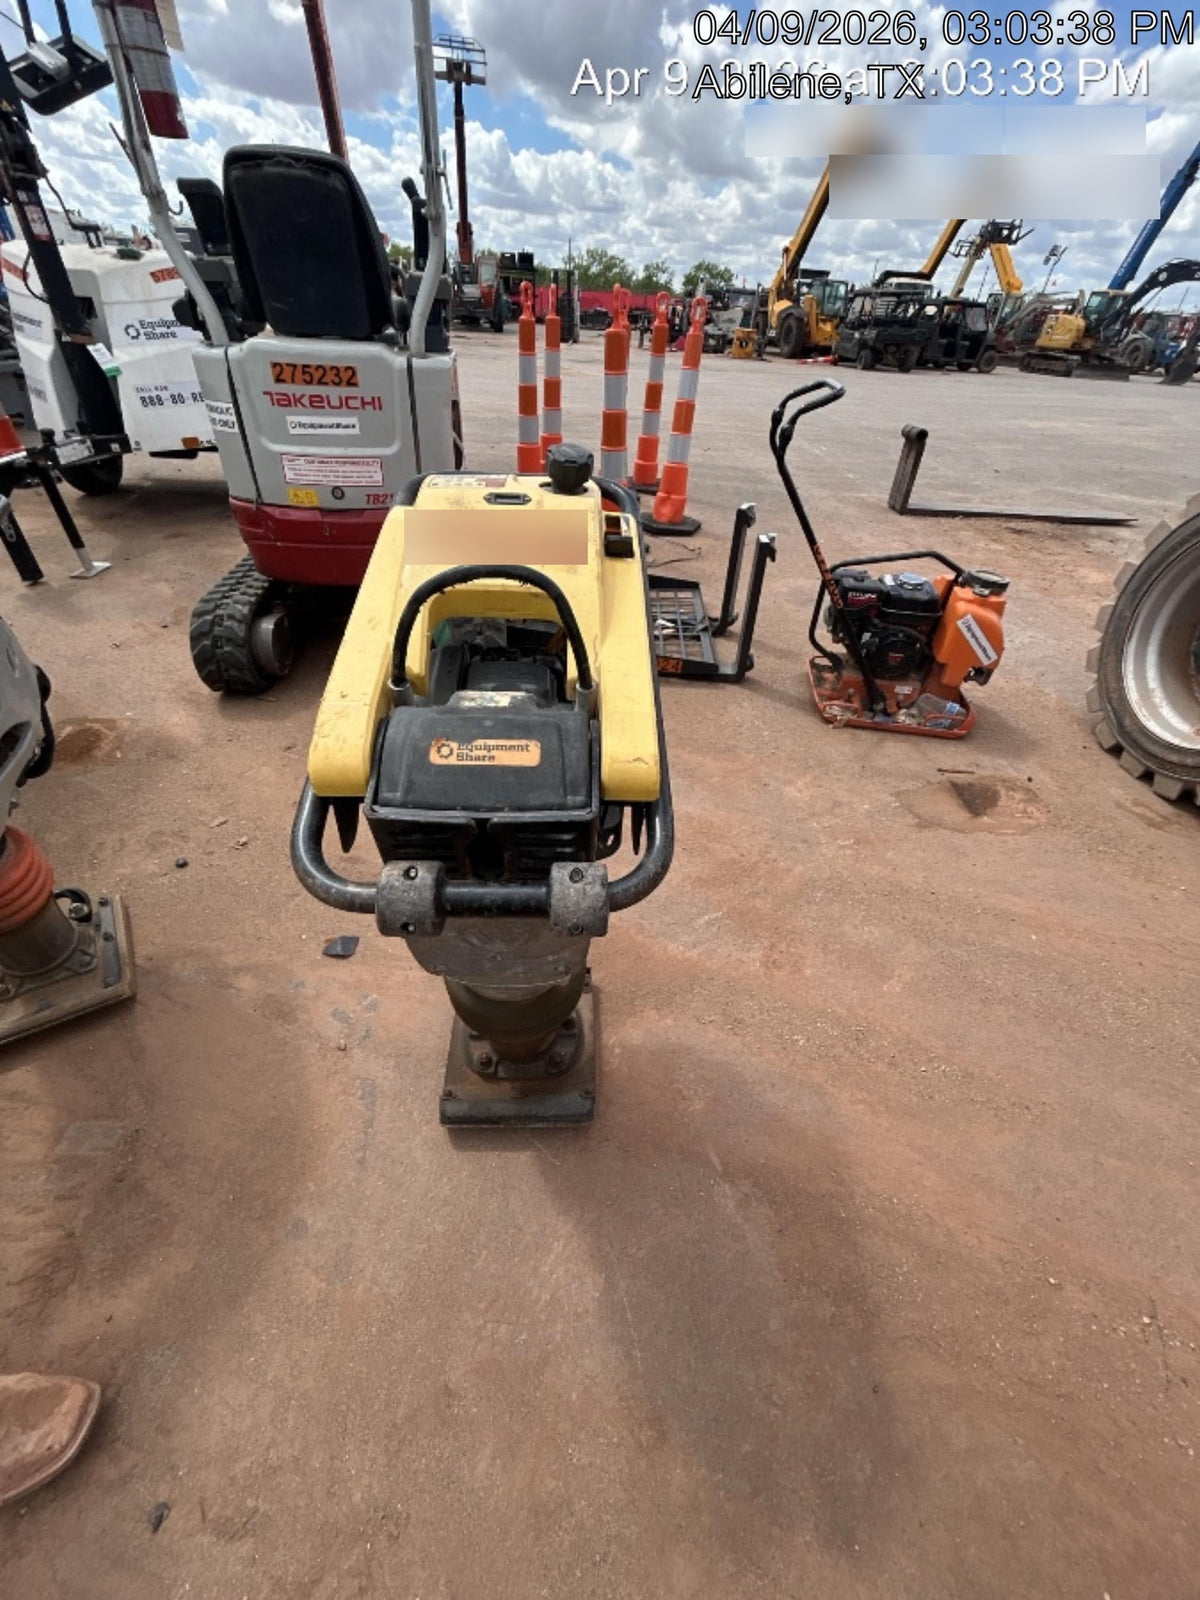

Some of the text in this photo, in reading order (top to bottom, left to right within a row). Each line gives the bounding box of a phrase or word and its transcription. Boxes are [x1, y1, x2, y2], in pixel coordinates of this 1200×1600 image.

[138, 318, 180, 331] Equipm
[143, 329, 178, 340] Share
[272, 362, 358, 386] 275232
[365, 492, 394, 505] TB21
[456, 742, 531, 752] Equipment
[456, 751, 496, 762] Share
